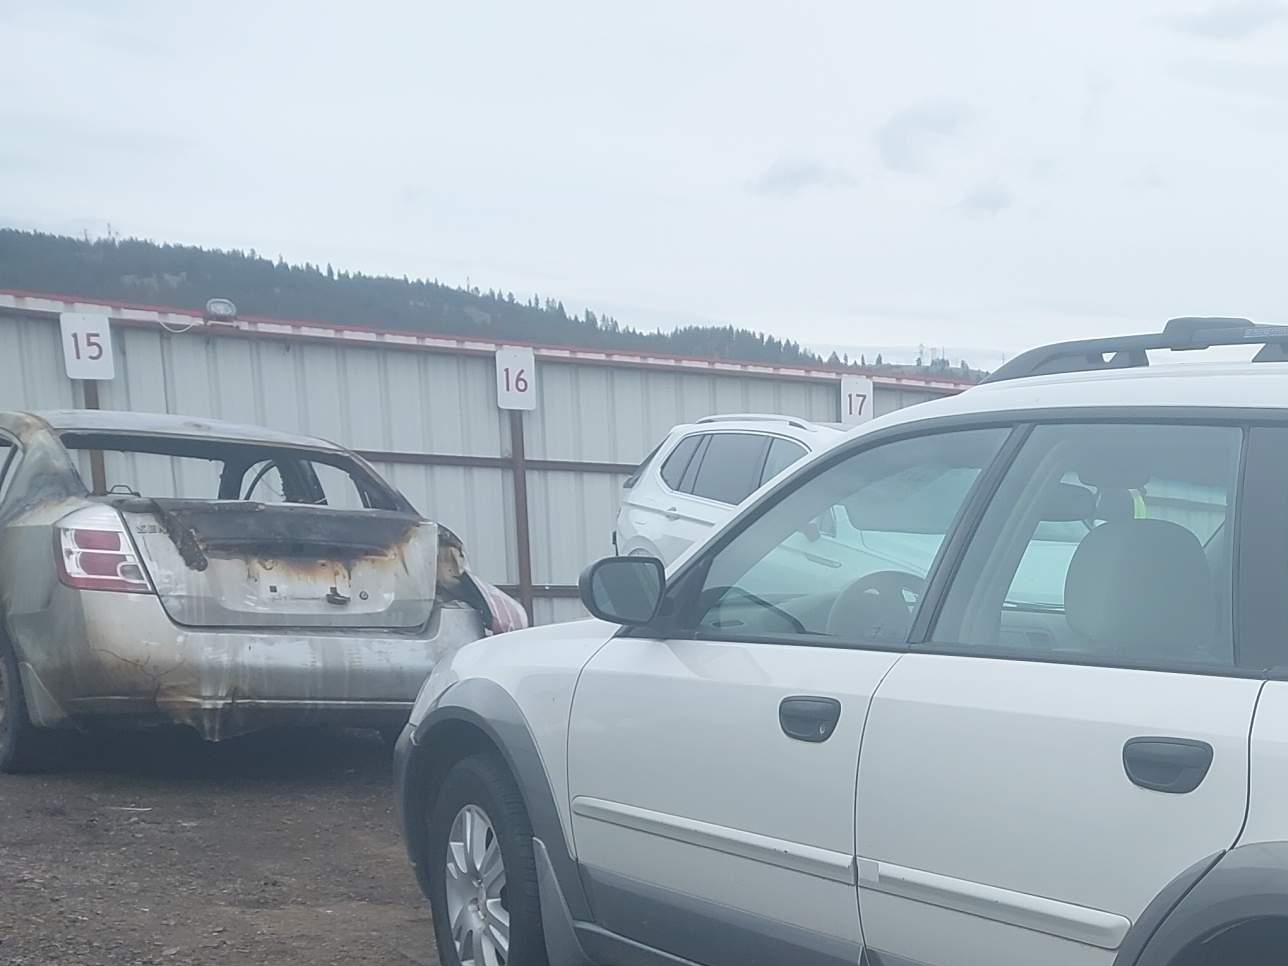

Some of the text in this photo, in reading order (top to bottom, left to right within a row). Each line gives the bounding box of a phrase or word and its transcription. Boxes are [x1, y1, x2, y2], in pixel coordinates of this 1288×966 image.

[71, 332, 103, 360] 15
[503, 367, 528, 393] 16
[847, 393, 867, 416] 17
